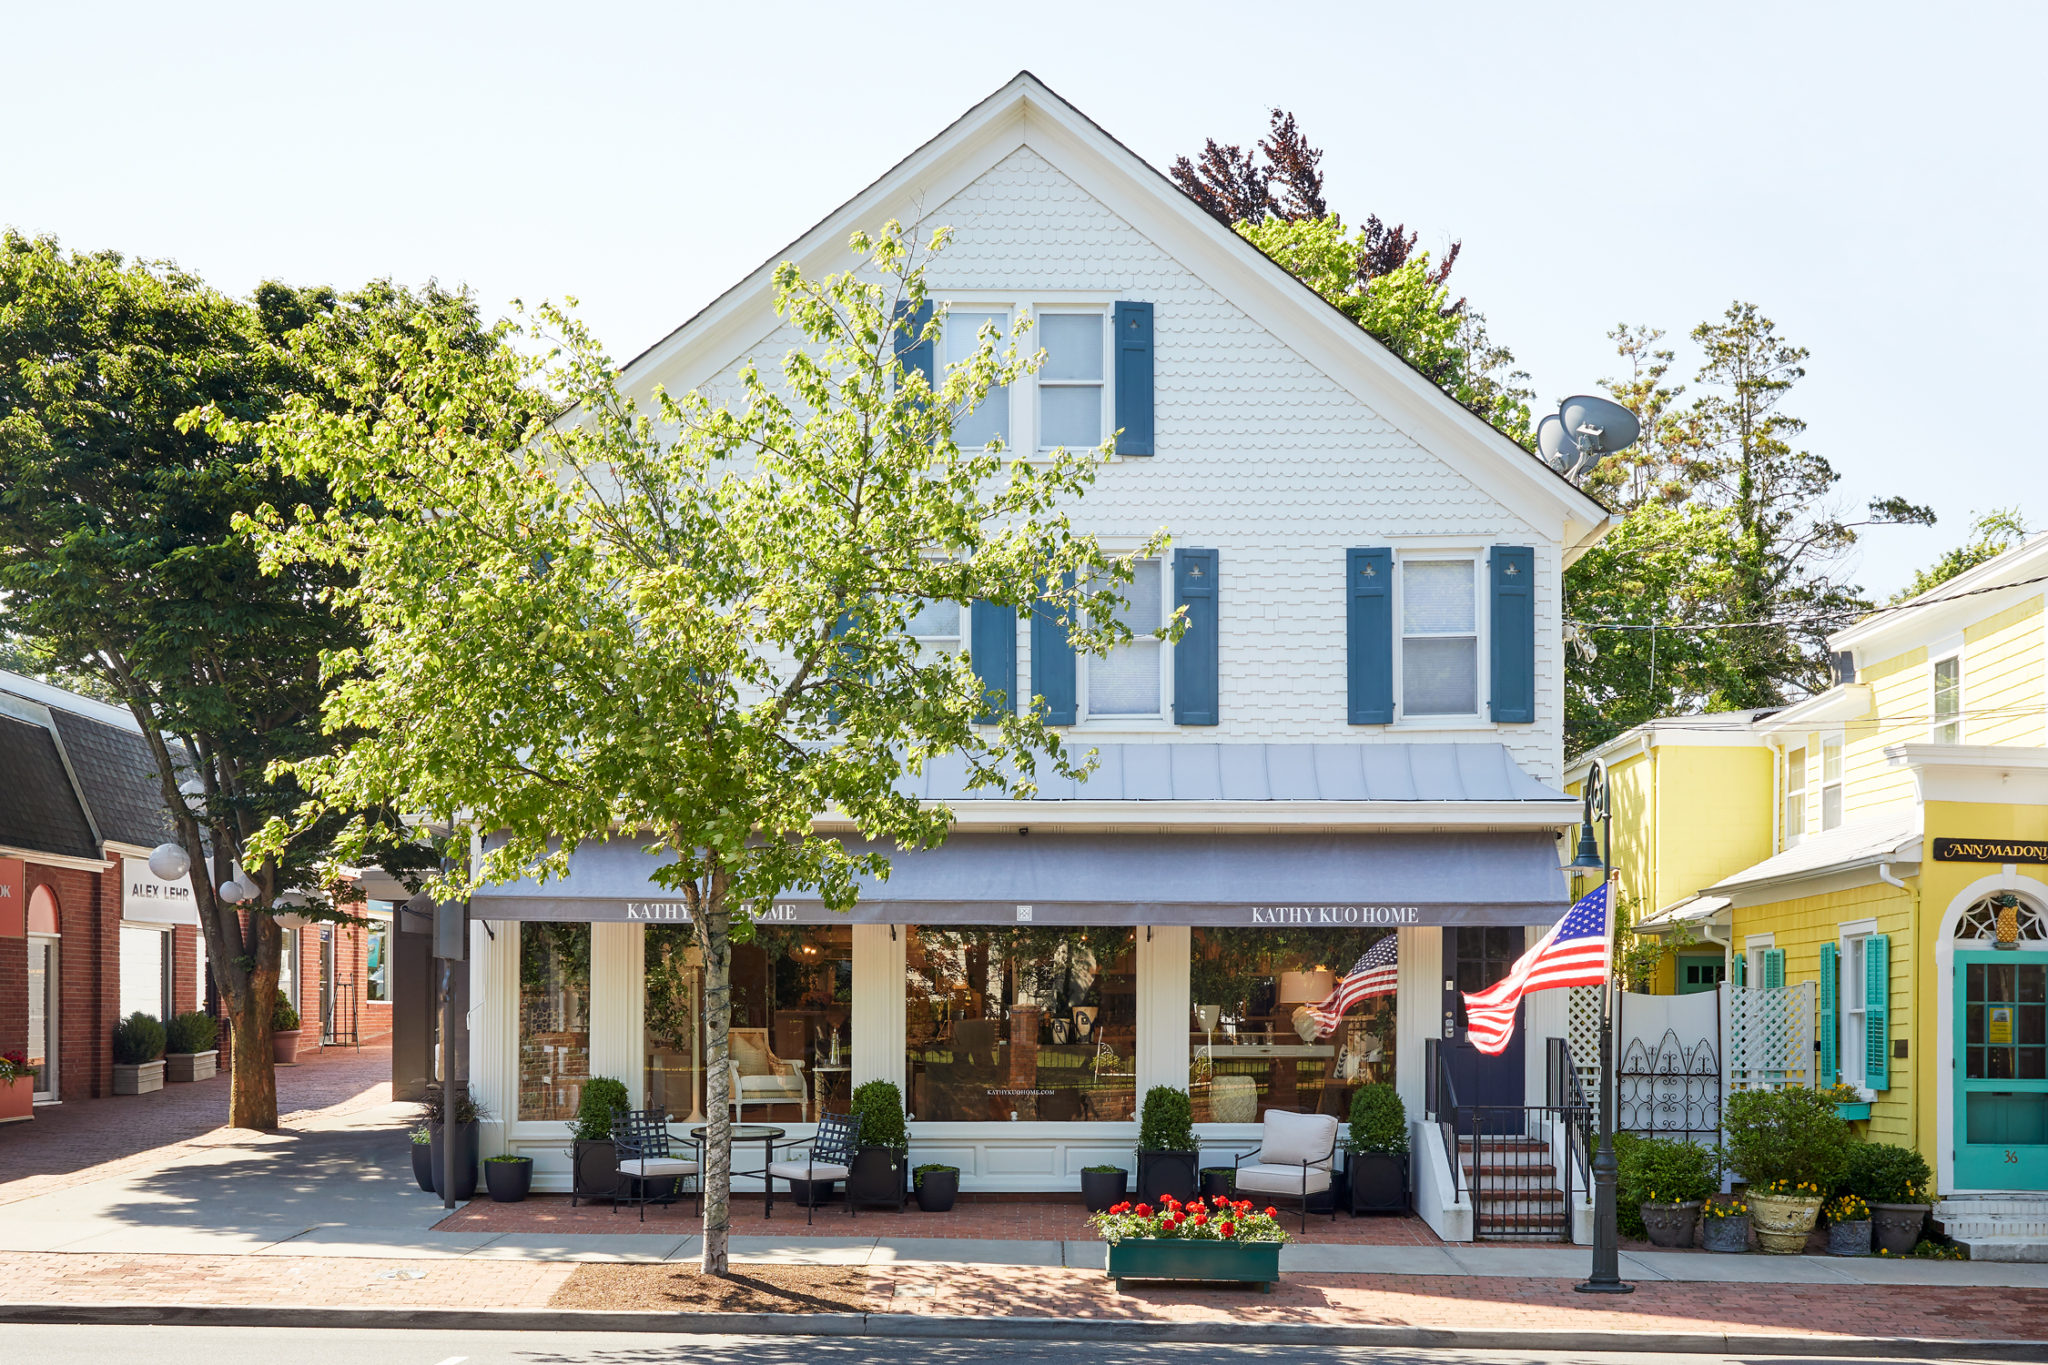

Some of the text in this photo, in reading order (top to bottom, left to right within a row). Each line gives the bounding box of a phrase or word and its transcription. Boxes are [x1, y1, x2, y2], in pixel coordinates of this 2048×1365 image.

[1944, 844, 2048, 860] ANN MADONI
[132, 883, 189, 901] ALEX LEHR
[626, 903, 689, 919] KATHY
[1252, 907, 1419, 923] KATHY KUO HOME
[2003, 1150, 2018, 1163] 36
